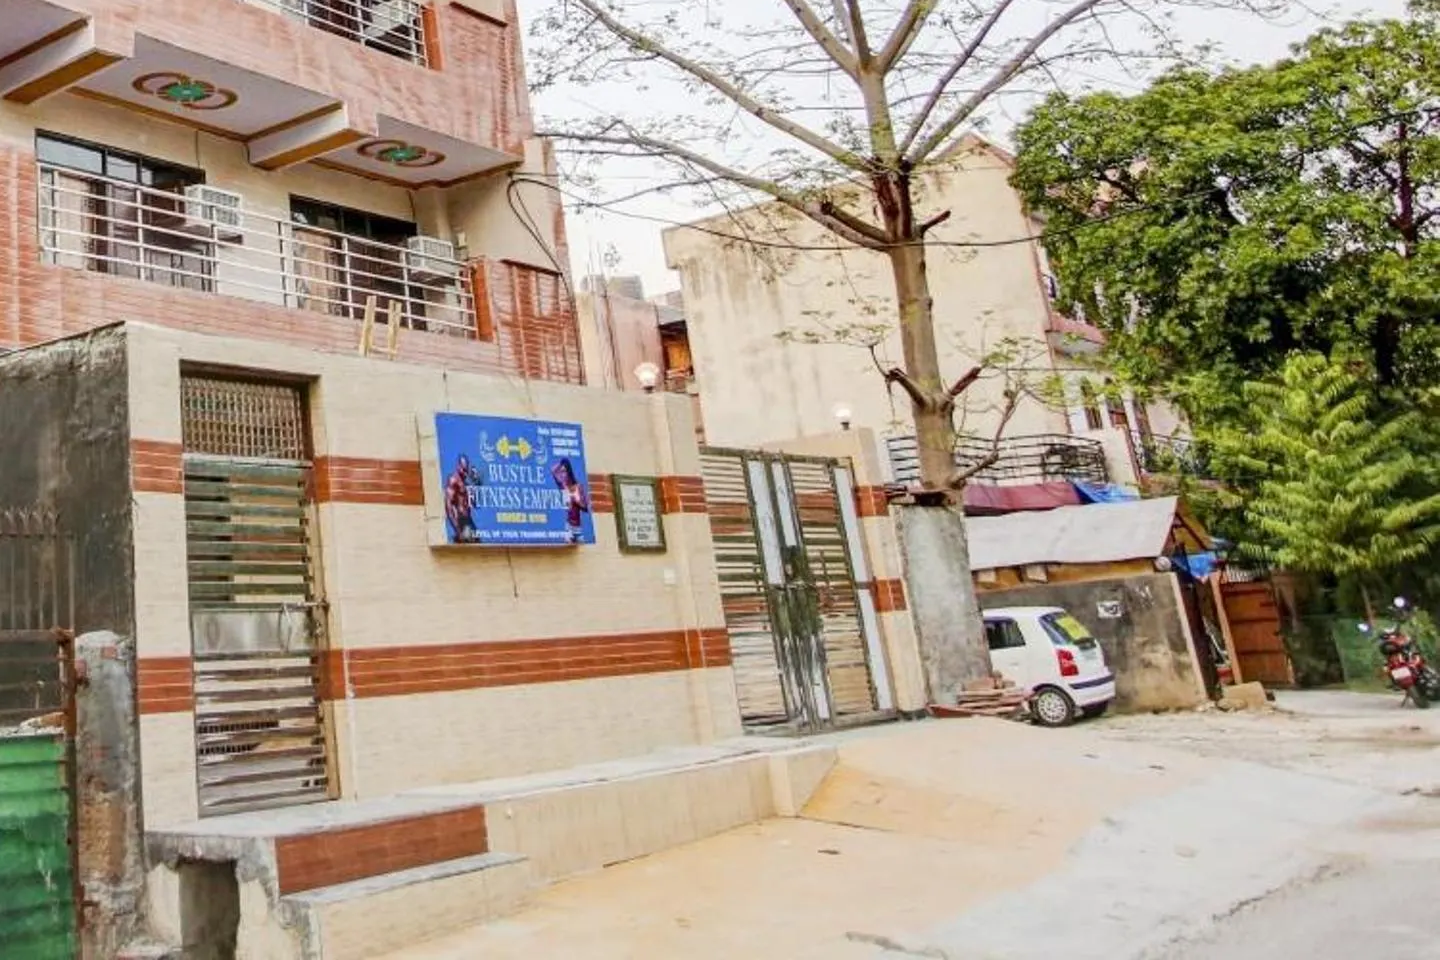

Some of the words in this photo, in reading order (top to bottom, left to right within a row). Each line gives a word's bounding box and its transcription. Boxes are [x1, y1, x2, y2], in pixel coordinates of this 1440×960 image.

[489, 463, 545, 484] BUSTLE
[466, 485, 521, 509] FITNESS
[523, 488, 569, 510] EMPIRE
